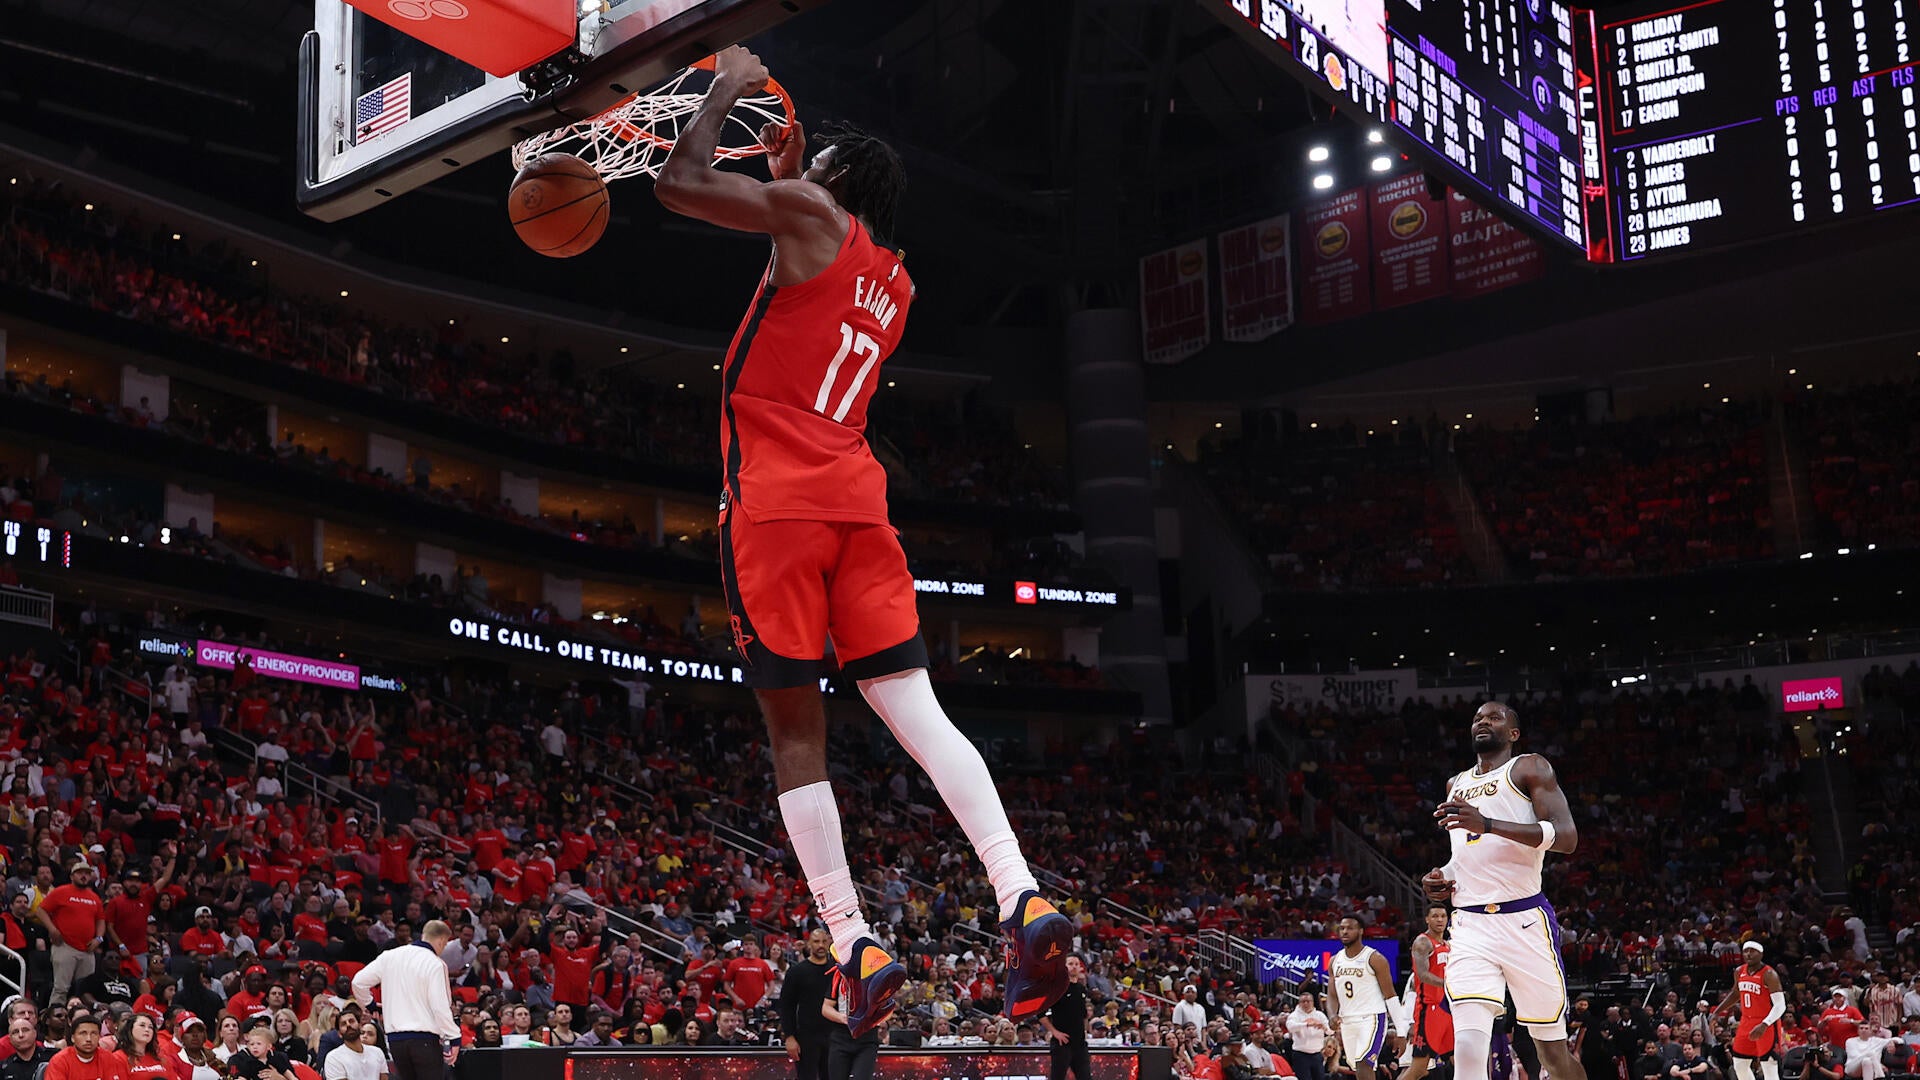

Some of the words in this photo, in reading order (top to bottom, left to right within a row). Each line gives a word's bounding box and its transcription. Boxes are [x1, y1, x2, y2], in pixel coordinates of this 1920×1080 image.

[1301, 27, 1318, 71] 23
[1616, 28, 1625, 45] 0
[1632, 14, 1682, 41] HOLIDAY
[1617, 68, 1631, 86] 10
[1635, 58, 1675, 82] SMITH
[1676, 55, 1695, 74] JR.
[1778, 31, 1787, 50] 7
[1815, 21, 1826, 40] 2
[1854, 11, 1865, 29] 0
[1894, 0, 1902, 18] 1
[1618, 48, 1627, 65] 2
[1633, 26, 1719, 62] FINNEY-SMITH
[1775, 10, 1786, 28] 0
[1814, 0, 1822, 18] 1
[1621, 109, 1633, 127] 17
[1639, 99, 1679, 124] EASON
[1781, 74, 1792, 92] 2
[1819, 64, 1830, 82] 5
[1858, 54, 1869, 73] 2
[1898, 43, 1909, 62] 2
[1623, 90, 1629, 106] 1
[1636, 72, 1705, 103] THOMPSON
[1779, 53, 1790, 71] 2
[1817, 43, 1828, 61] 0
[1856, 32, 1867, 51] 2
[1895, 22, 1906, 40] 2
[1776, 96, 1799, 115] PTS
[1813, 86, 1837, 107] REB
[1852, 76, 1875, 97] AST
[1892, 67, 1914, 87] FLS
[1581, 119, 1600, 179] FIRE
[1626, 151, 1635, 169] 2
[1642, 134, 1715, 165] VANDERBILT
[1785, 117, 1796, 135] 2
[1825, 107, 1833, 125] 1
[1862, 97, 1873, 116] 0
[1902, 87, 1913, 106] 0
[1628, 172, 1637, 189] 9
[1645, 162, 1684, 187] JAMES
[1787, 138, 1798, 156] 0
[1826, 129, 1836, 147] 0
[1866, 119, 1874, 137] 1
[1904, 109, 1916, 128] 0
[1628, 213, 1644, 232] 28
[1647, 198, 1722, 229] HACHIMURA
[1792, 181, 1802, 199] 2
[1830, 172, 1841, 191] 0
[1869, 163, 1880, 182] 0
[1909, 154, 1920, 172] 0
[1630, 193, 1639, 210] 5
[1646, 183, 1687, 208] AYTON
[1790, 159, 1800, 177] 4
[1828, 150, 1837, 169] 7
[1867, 141, 1878, 160] 0
[1908, 132, 1916, 150] 1
[1377, 185, 1425, 204] ROCKET
[1630, 234, 1646, 253] 23
[1650, 226, 1690, 250] JAMES
[1832, 194, 1843, 213] 3
[1872, 185, 1883, 204] 2
[854, 276, 898, 331] EASON
[814, 322, 880, 423] 17
[4, 521, 20, 537] FLS
[6, 535, 16, 555] 0
[40, 541, 47, 561] 1
[952, 582, 984, 595] ZONE
[1038, 588, 1083, 602] TUNDRA
[1086, 592, 1117, 604] ZONE
[140, 638, 180, 655] reliant
[202, 647, 255, 668] OFFIC
[257, 656, 301, 674] ENERGY
[302, 664, 355, 683] PROVIDER
[450, 618, 489, 641] ONE
[498, 628, 550, 653] CALL.
[558, 640, 594, 662] ONE
[600, 649, 653, 672] TEAM.
[662, 659, 723, 681] TOTAL
[362, 675, 396, 691] reliant
[1786, 690, 1825, 703] reliant
[1336, 966, 1364, 978] LAKERS
[1345, 981, 1353, 998] 9
[1744, 993, 1751, 1008] 0
